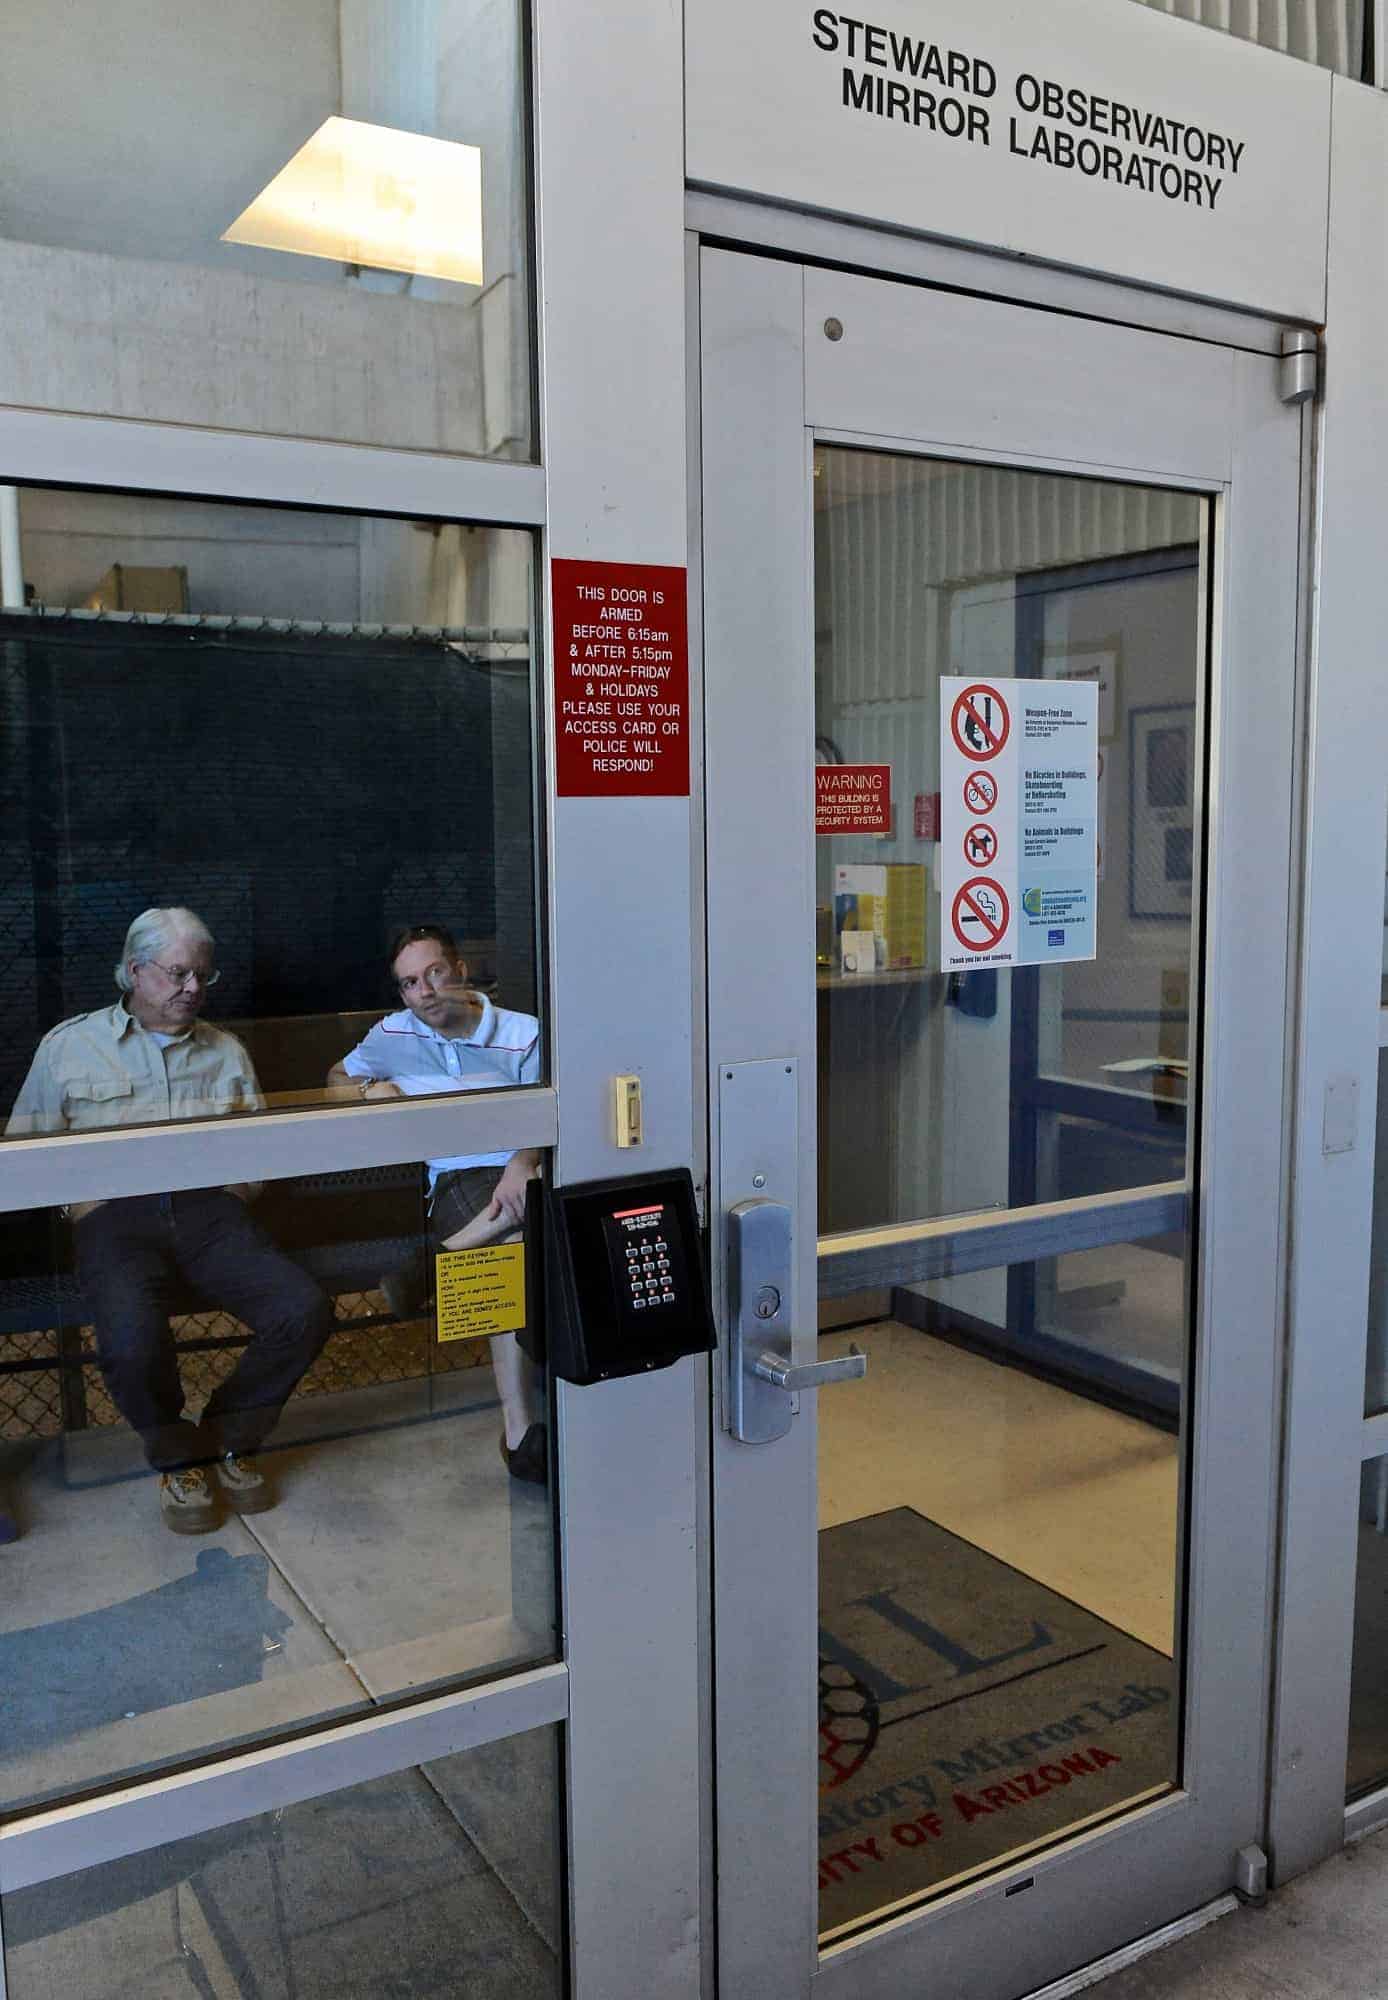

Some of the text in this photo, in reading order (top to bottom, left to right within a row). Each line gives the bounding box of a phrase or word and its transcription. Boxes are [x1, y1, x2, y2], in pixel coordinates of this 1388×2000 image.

[813, 9, 1245, 173] STEWARD OBSERVATORY
[842, 68, 1222, 209] MIRROR LABORATORY
[576, 586, 664, 604] THIS DOOR IS
[600, 607, 642, 621] ARMED
[573, 625, 669, 642] BEFORE 6:15am
[569, 644, 673, 662] & AFTER 5:15pm
[571, 664, 671, 679] MONDAY-FRIDAY
[585, 683, 658, 697] & HOLIDAYS
[563, 702, 680, 716] PLEASE USE YOUR
[565, 721, 679, 735] ACCESS CARD OR
[583, 740, 662, 753] POLICE WILL
[593, 759, 654, 772] RESPOND!
[817, 774, 882, 790] WARNING
[820, 793, 879, 803] THIS BUILDING IS
[816, 805, 882, 814] PROTECTED BY A
[815, 816, 883, 826] SECURITY SYSTEM
[819, 1746, 1122, 1889] ITY OF ARIZONA
